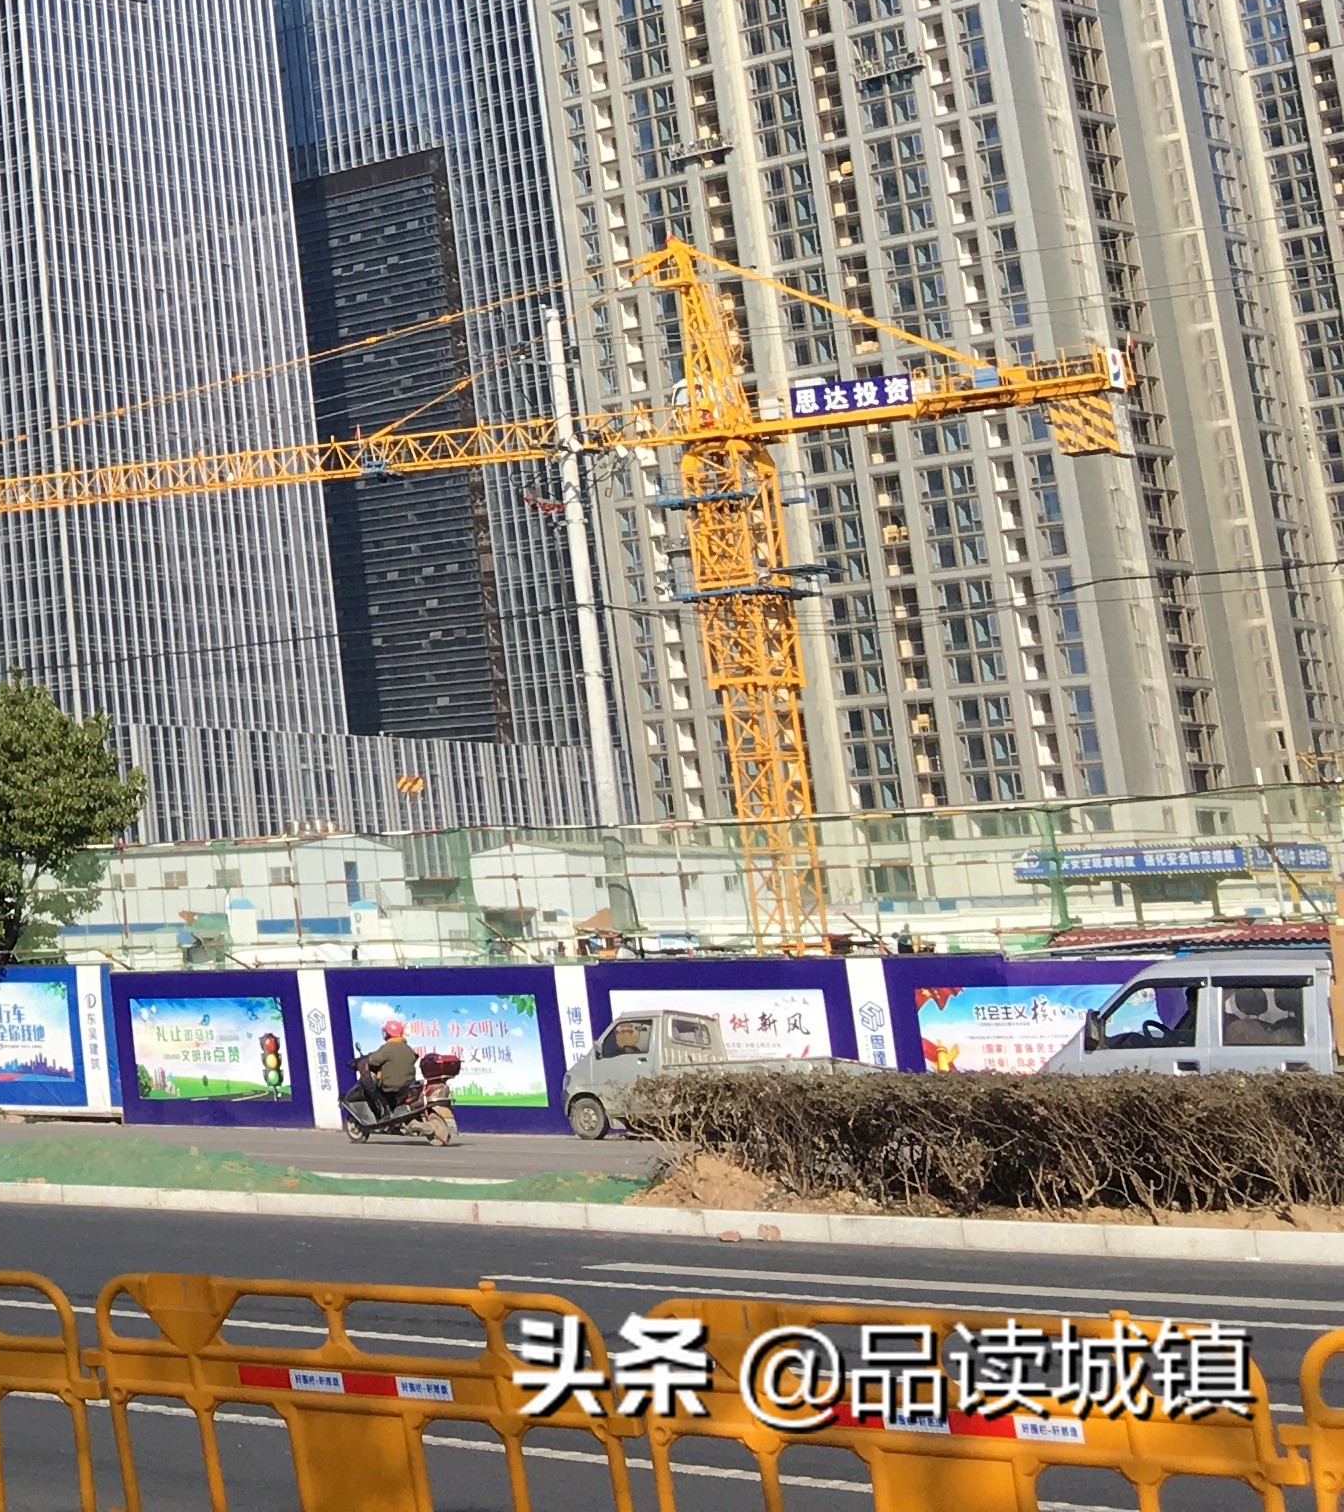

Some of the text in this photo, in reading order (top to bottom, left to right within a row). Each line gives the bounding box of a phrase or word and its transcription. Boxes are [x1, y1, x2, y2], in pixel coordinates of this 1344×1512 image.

[795, 377, 909, 414] 思达投资
[155, 1025, 215, 1042] 礼让斑马线
[447, 1019, 510, 1038] 办文明事
[86, 1013, 101, 1071] 东吴建筑
[181, 1046, 241, 1063] 文明我点赞
